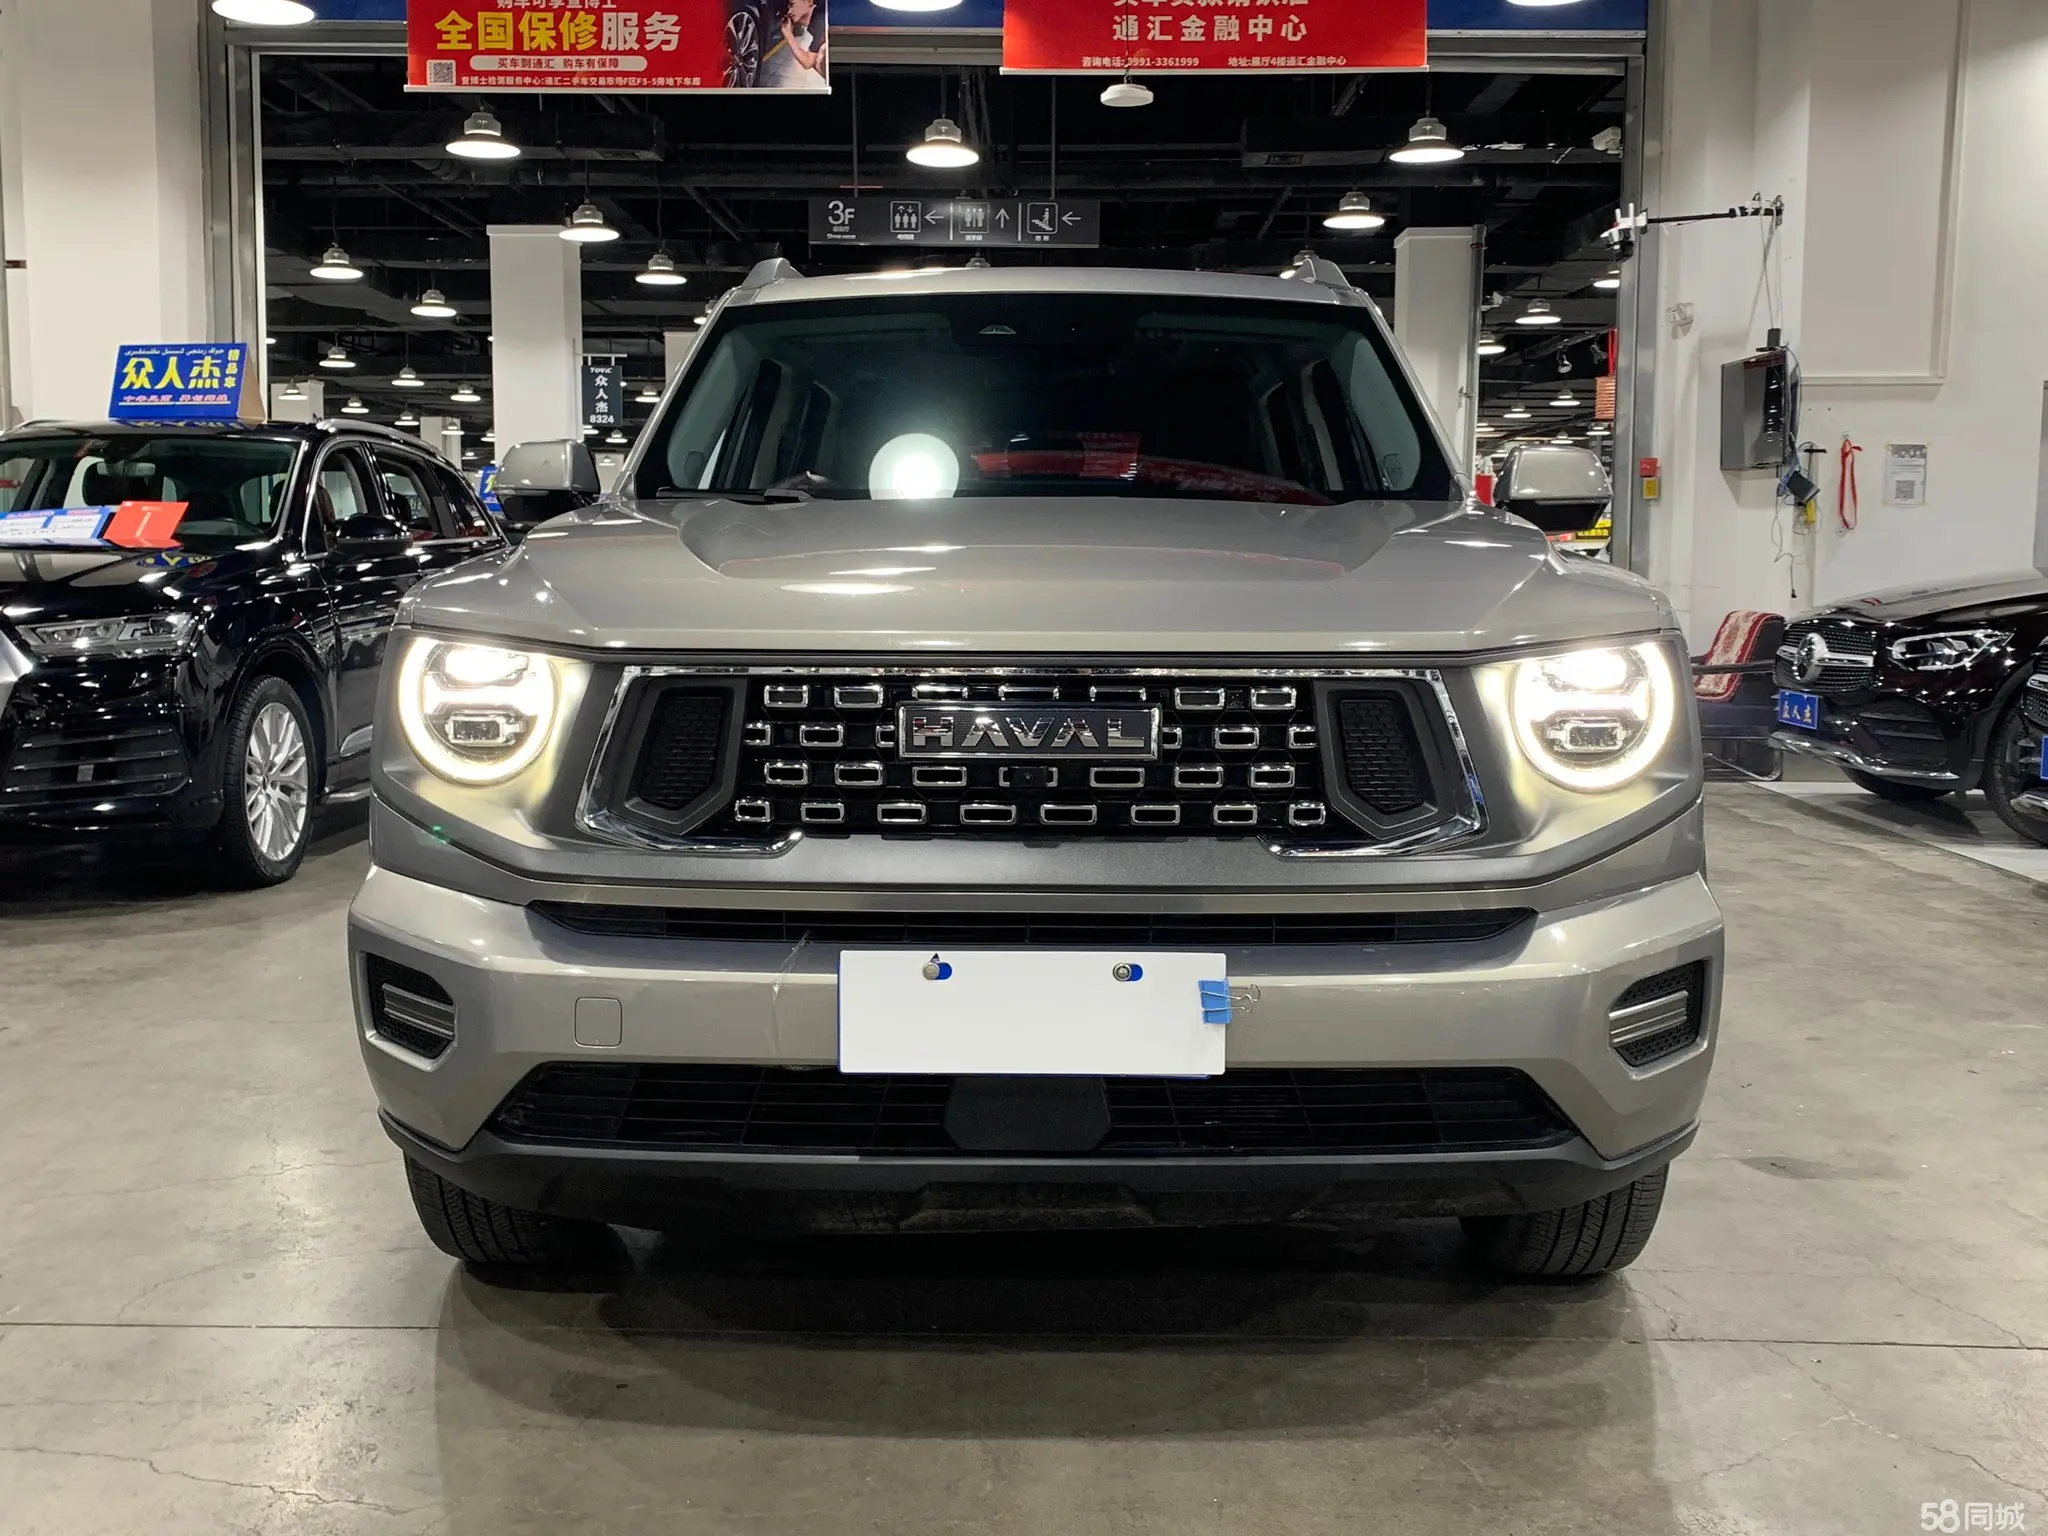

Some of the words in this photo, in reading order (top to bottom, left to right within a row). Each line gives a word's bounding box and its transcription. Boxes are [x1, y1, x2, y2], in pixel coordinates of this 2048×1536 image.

[434, 10, 682, 52] 全国保修服务
[1112, 14, 1308, 42] 通汇金融中心
[497, 58, 555, 69] 买车到通汇
[562, 58, 620, 69] 购车有保障
[827, 200, 855, 225] 3F
[119, 355, 222, 390] 众人杰
[594, 374, 609, 413] 众人杰
[589, 414, 615, 424] 8324
[912, 716, 1146, 748] HAVAL
